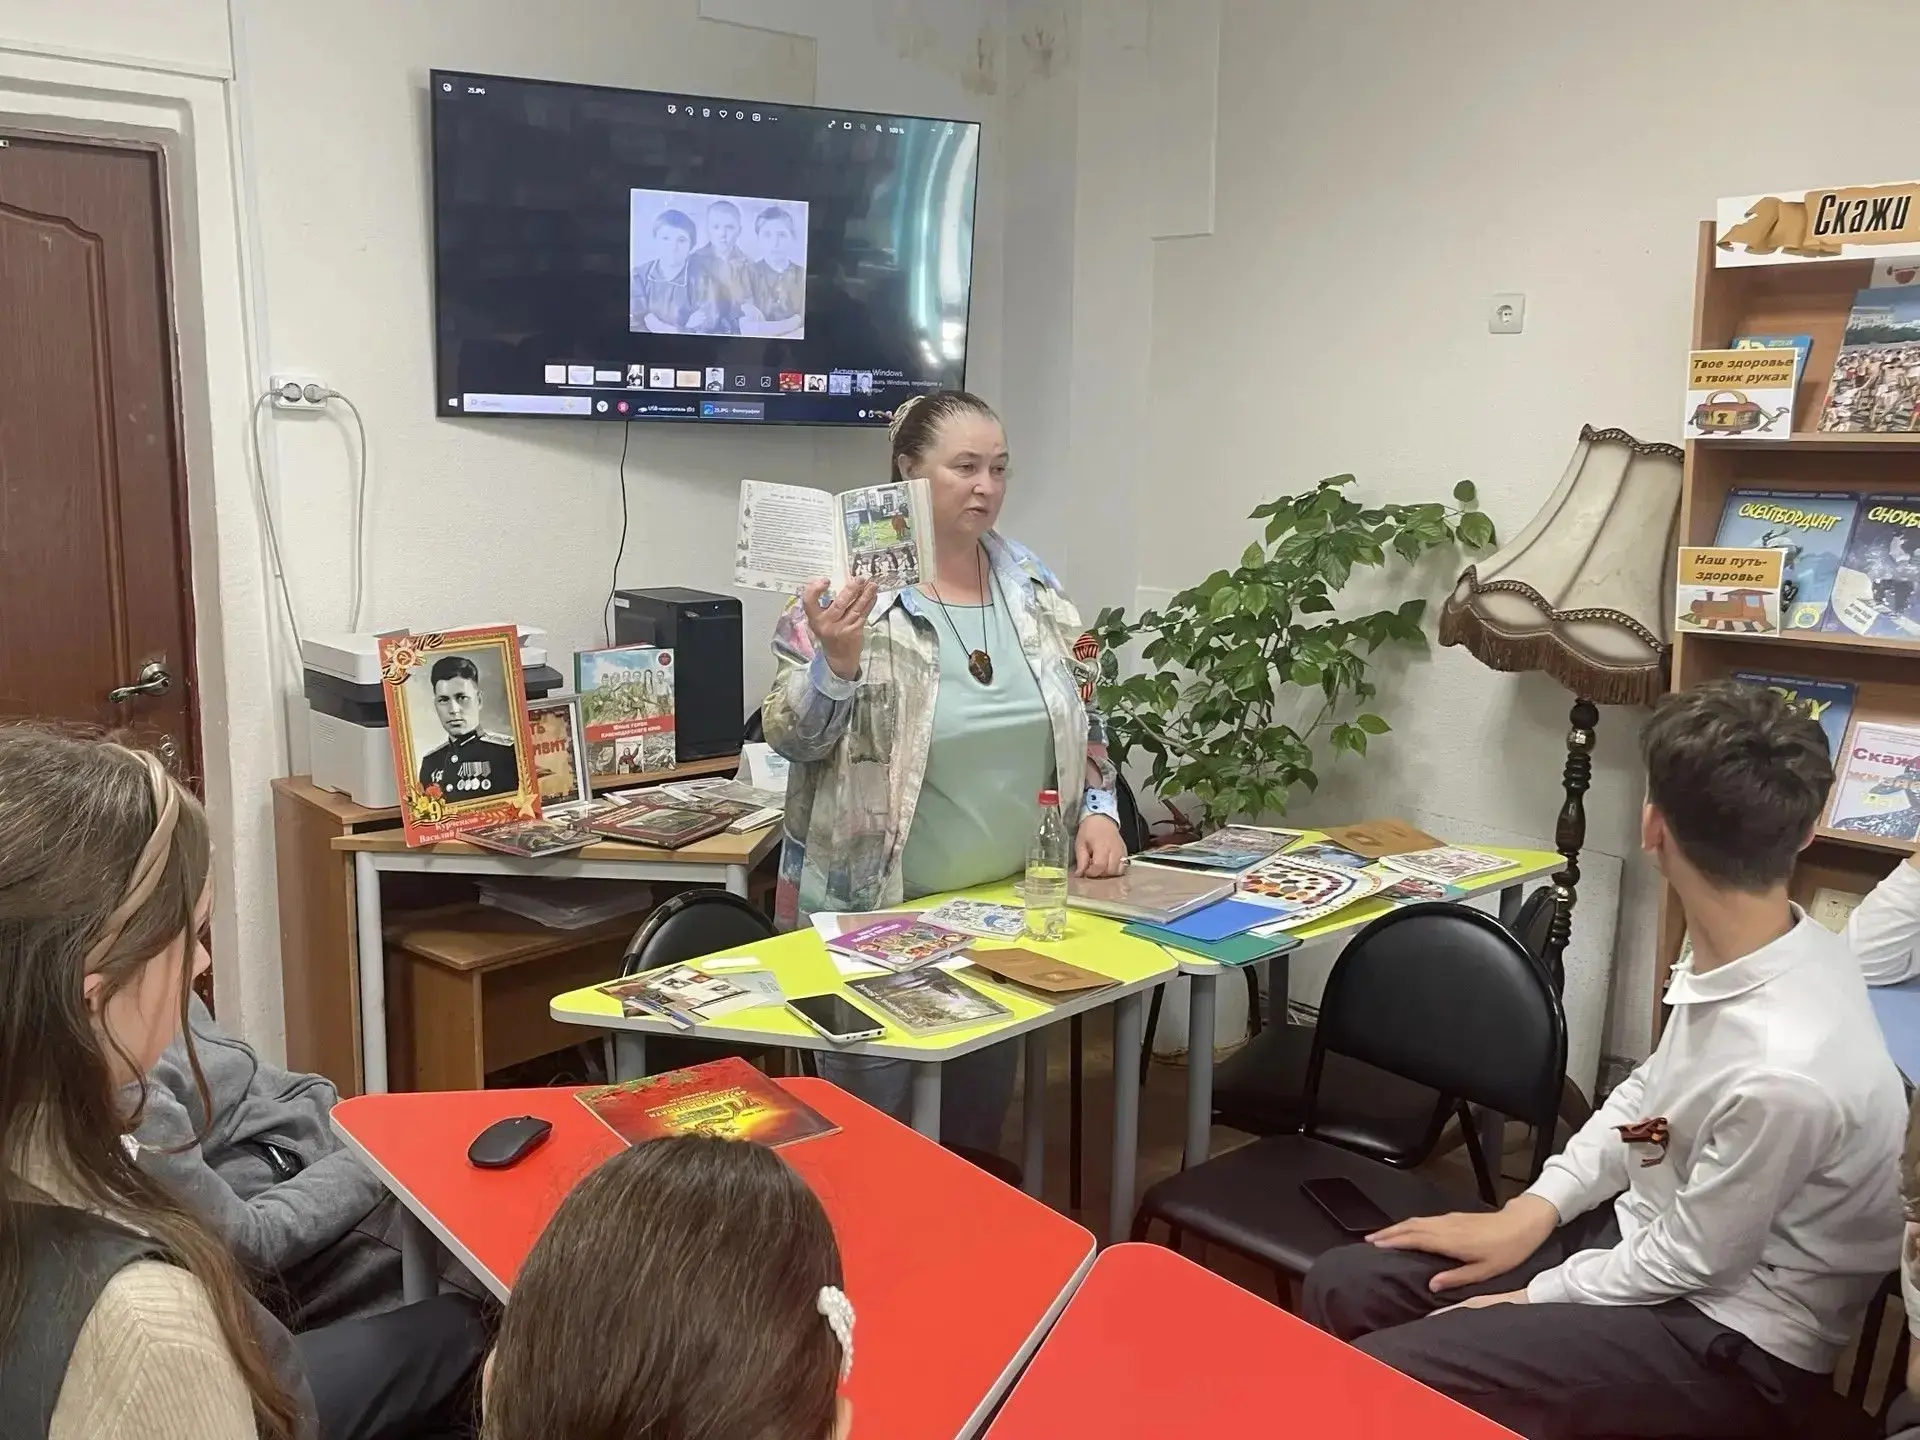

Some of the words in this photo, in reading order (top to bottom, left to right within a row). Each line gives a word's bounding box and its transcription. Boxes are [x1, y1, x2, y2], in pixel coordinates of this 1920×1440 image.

[1814, 194, 1912, 236] Скажи
[1693, 360, 1723, 370] Твое
[1728, 358, 1794, 371] здоровье
[1694, 375, 1702, 384] в
[1705, 374, 1742, 383] твоих
[1745, 372, 1790, 384] руках
[1738, 503, 1842, 532] СКЕЙТБОРДИНГ
[1695, 555, 1724, 566] Наш
[1730, 556, 1768, 568] путь-
[1695, 572, 1764, 582] здоровье
[419, 831, 455, 844] Василий
